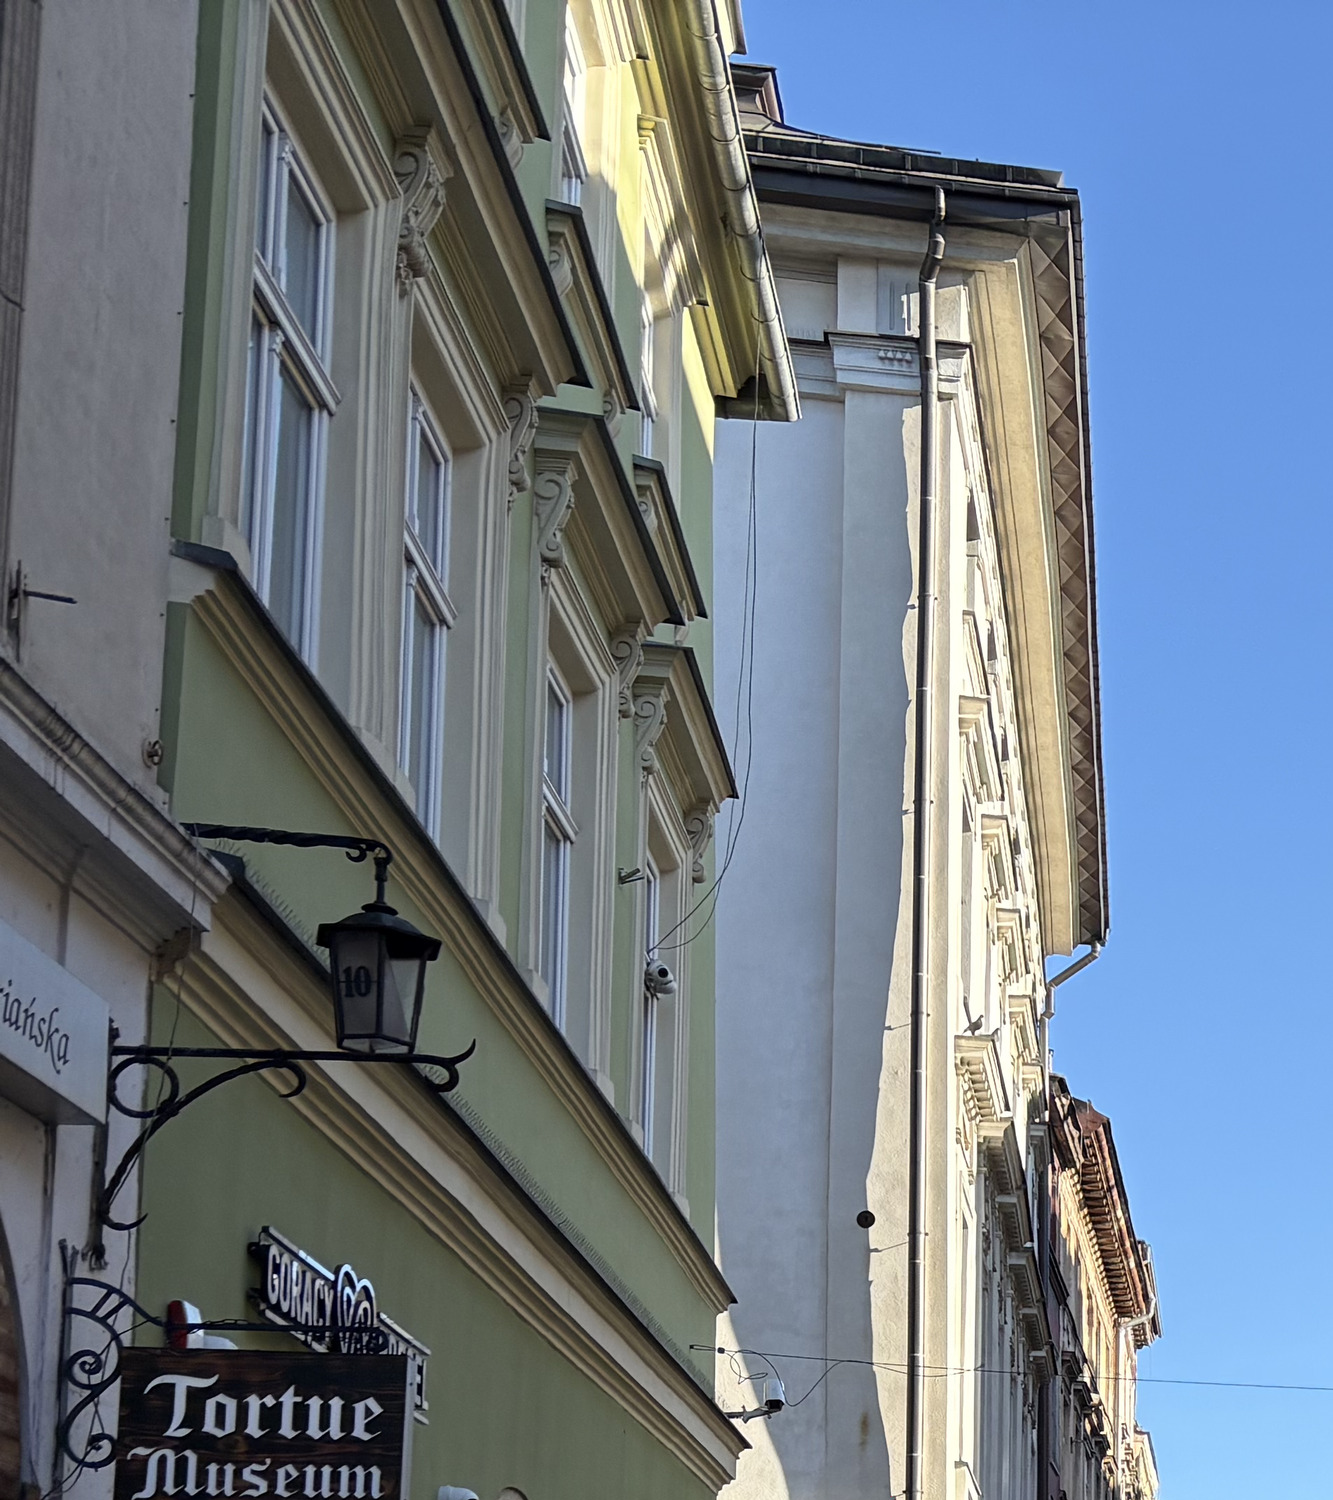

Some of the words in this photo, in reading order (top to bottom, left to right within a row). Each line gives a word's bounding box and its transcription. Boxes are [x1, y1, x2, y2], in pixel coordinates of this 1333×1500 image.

[342, 966, 371, 998] 10
[0, 979, 70, 1074] iańska
[144, 1374, 384, 1441] Tortue
[127, 1447, 385, 1500] Museum
